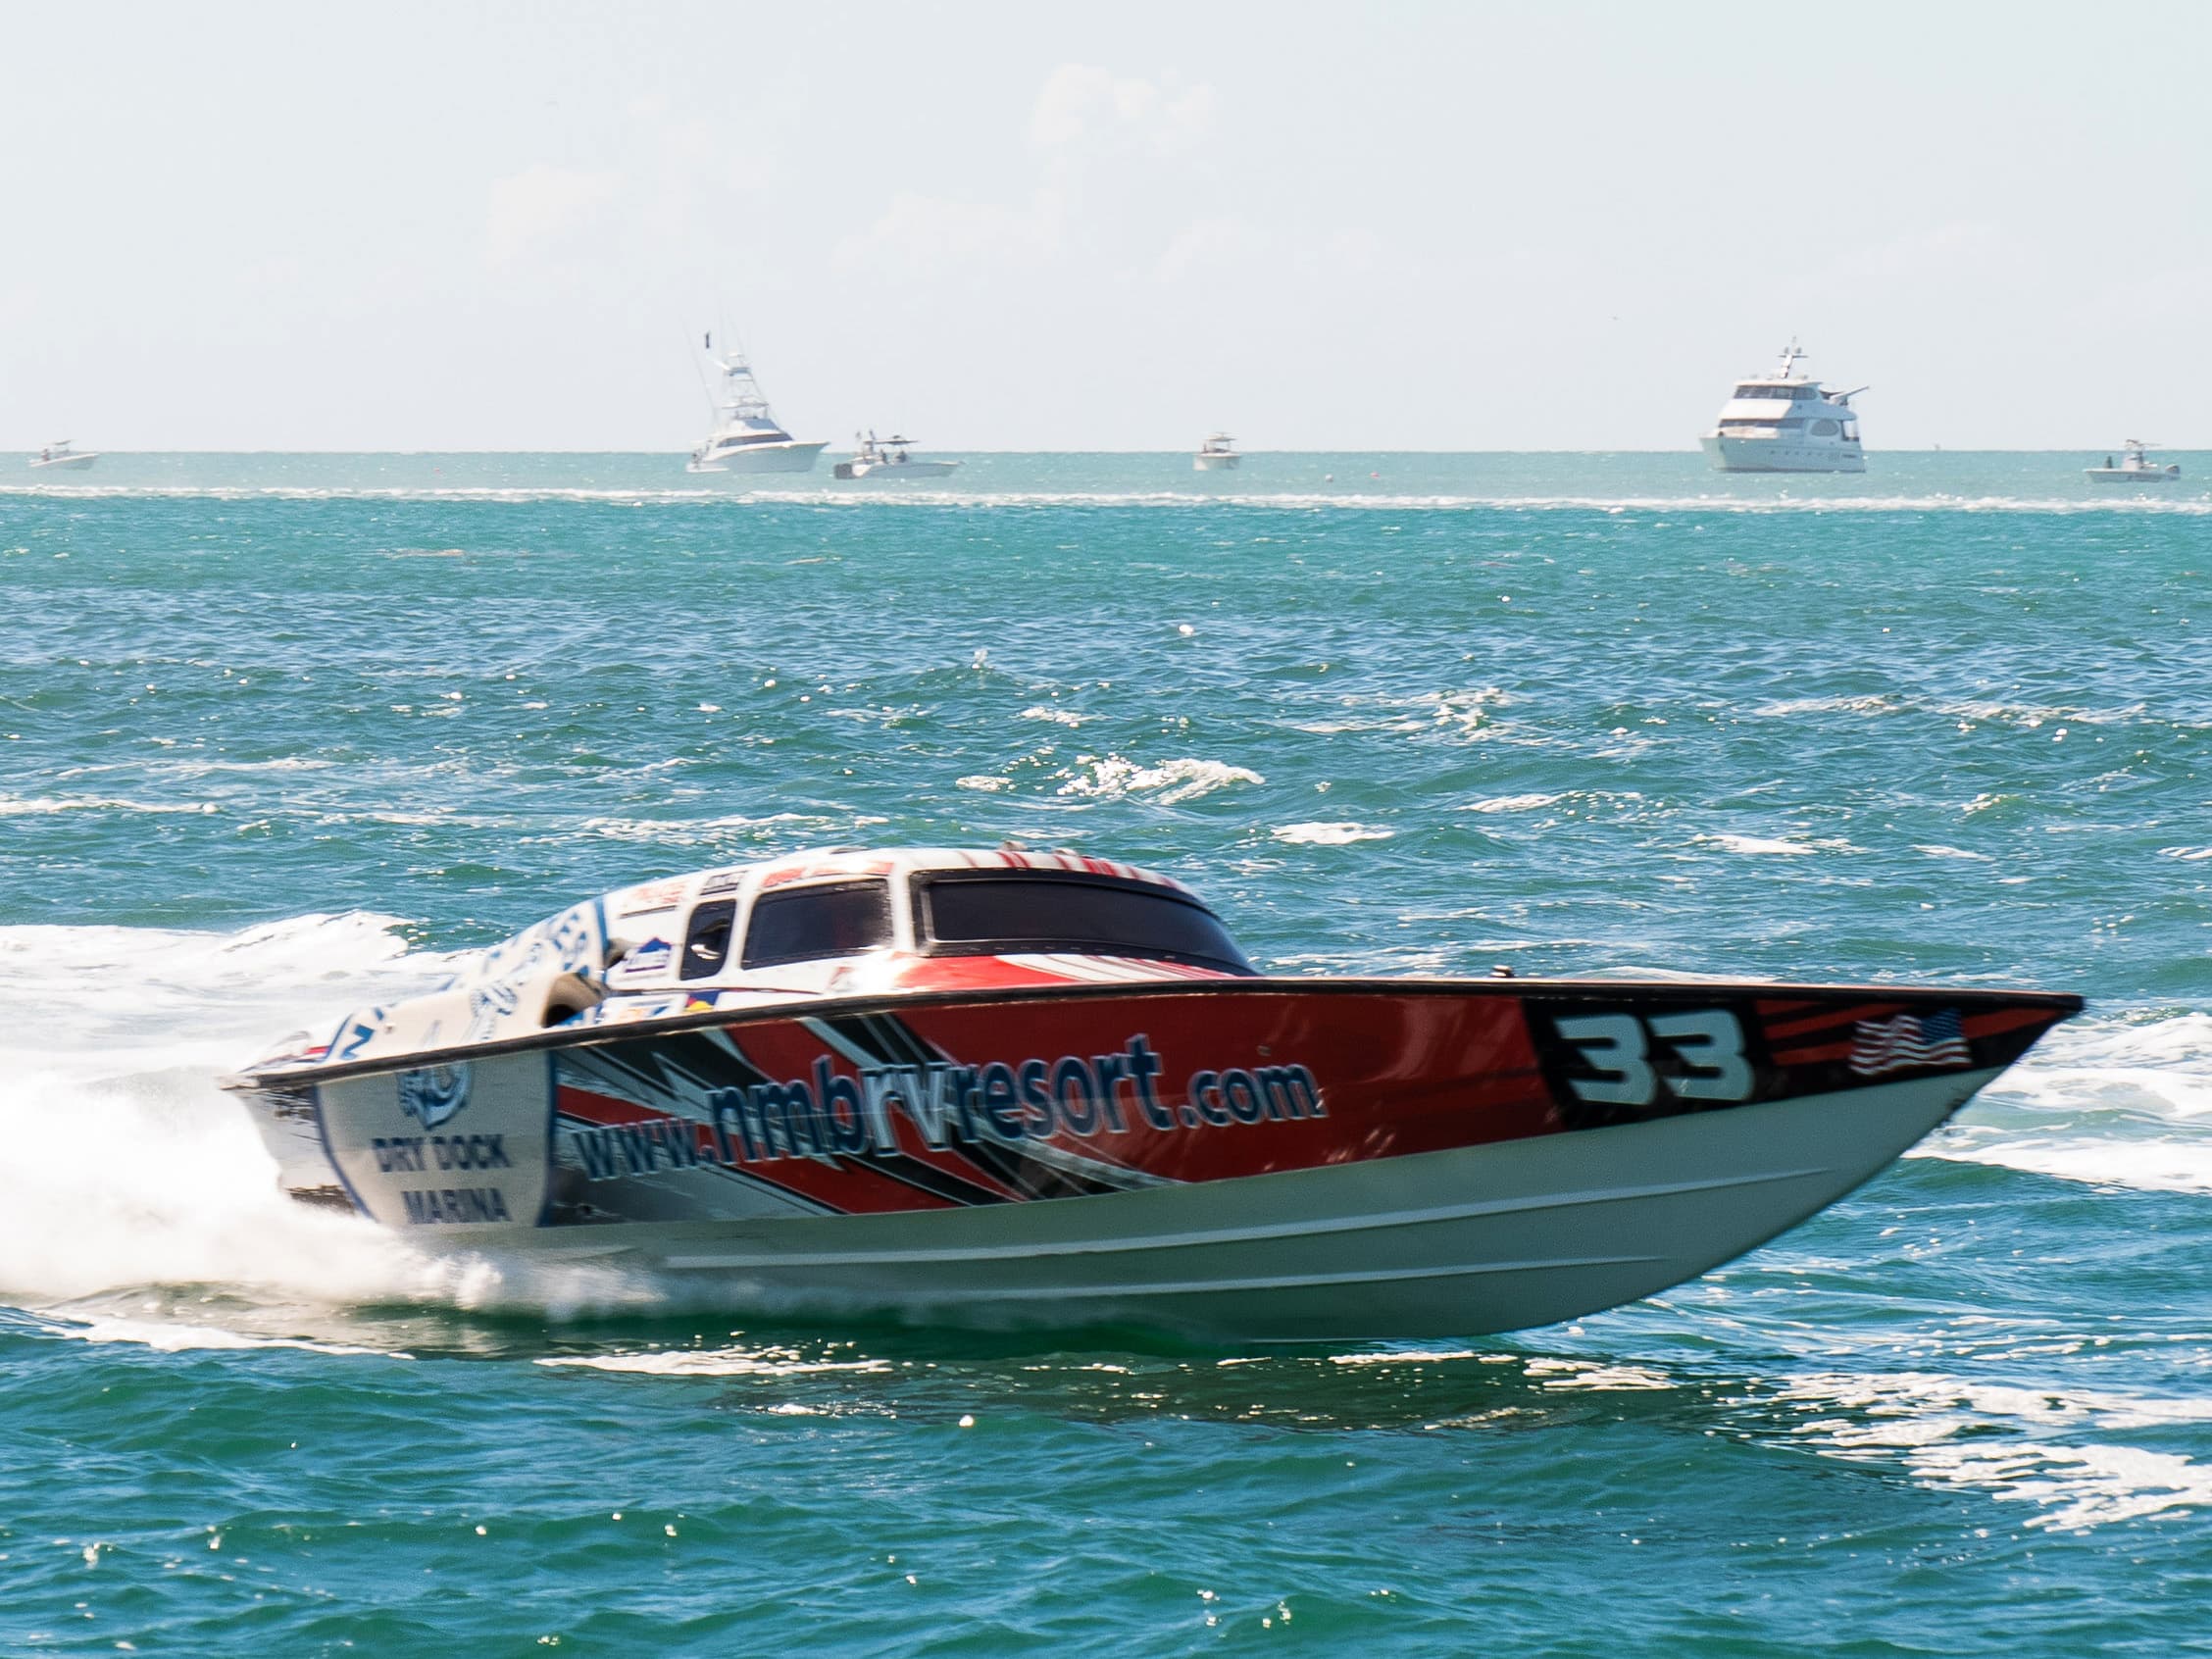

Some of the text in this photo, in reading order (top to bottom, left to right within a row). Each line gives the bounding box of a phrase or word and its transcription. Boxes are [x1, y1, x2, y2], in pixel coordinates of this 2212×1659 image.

[1553, 1009, 1755, 1106] 33
[570, 1034, 1329, 1181] www.nmbrvresort.com
[372, 1133, 512, 1172] DRY DOCK
[402, 1187, 513, 1225] MARINA
